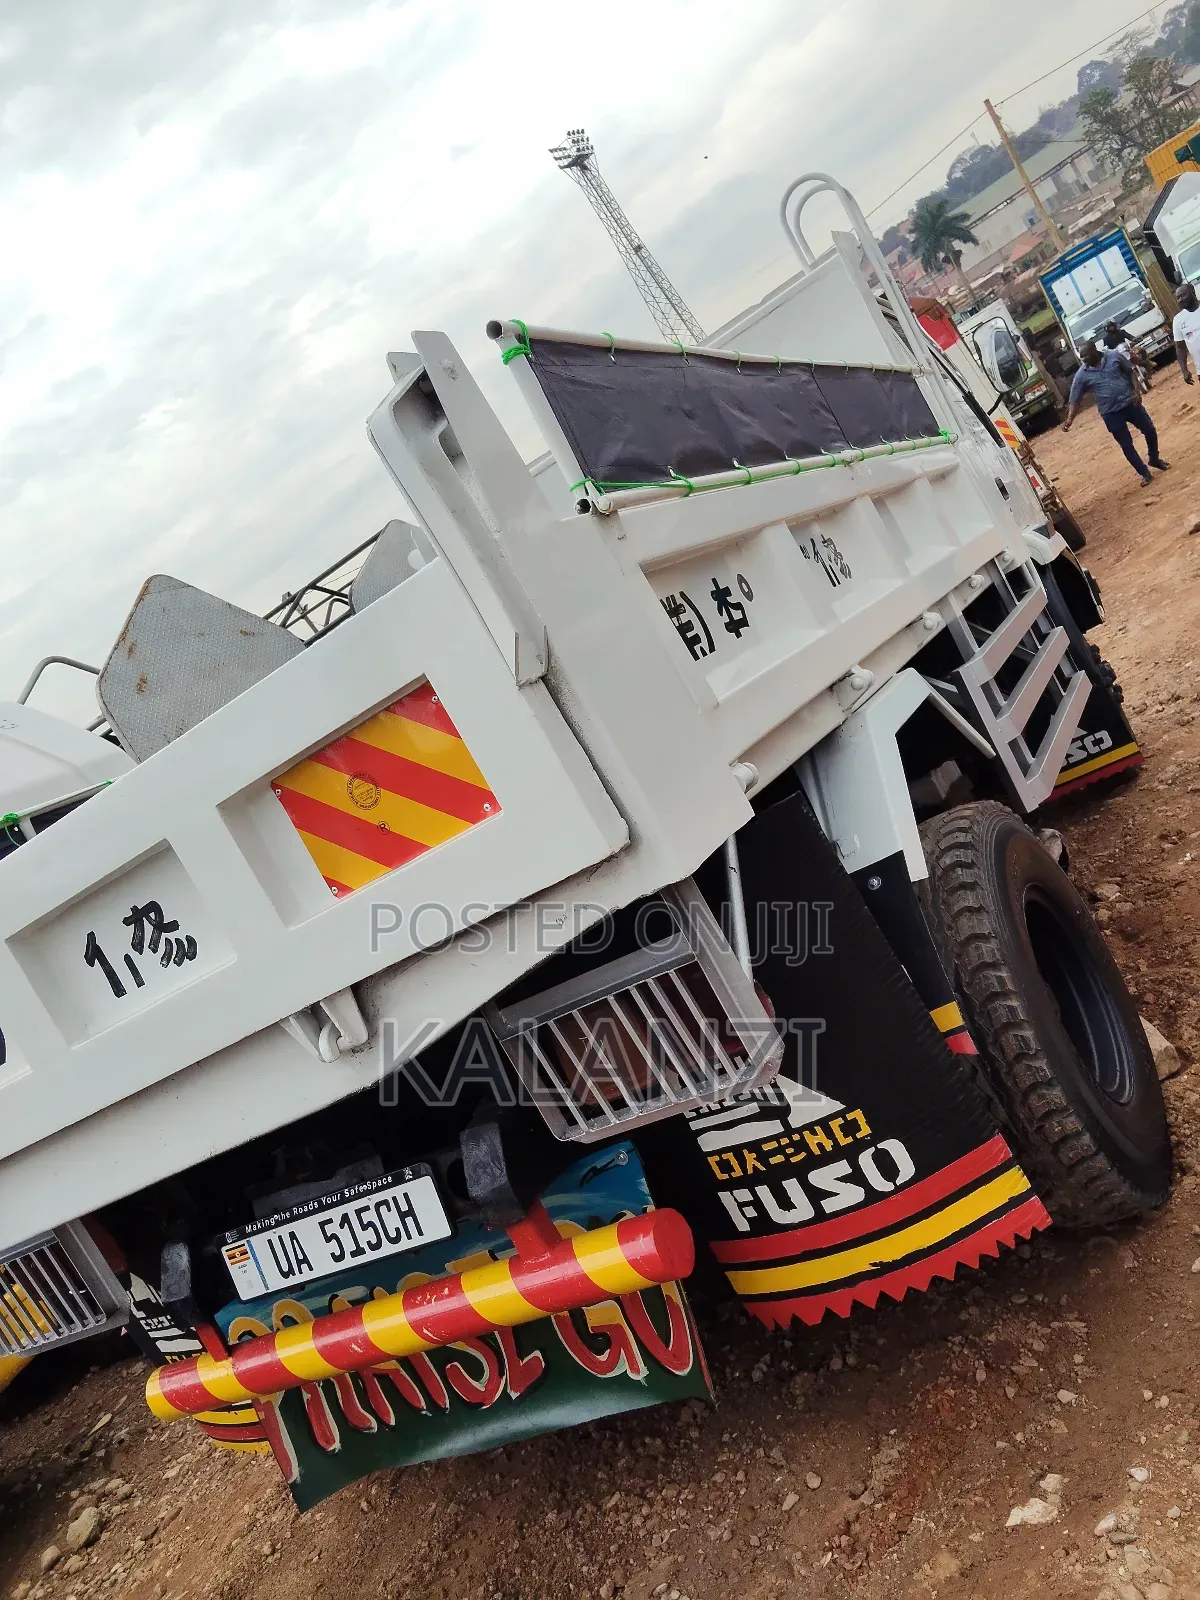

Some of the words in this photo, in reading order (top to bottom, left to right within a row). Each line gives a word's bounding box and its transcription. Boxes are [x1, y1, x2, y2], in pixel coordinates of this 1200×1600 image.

[245, 1217, 276, 1234] Making
[278, 1212, 291, 1221] the
[292, 1201, 319, 1216] Roads
[320, 1193, 341, 1206] Your
[344, 1183, 364, 1198] Safe
[366, 1175, 393, 1191] Space
[716, 1138, 916, 1232] FUSO
[266, 1230, 314, 1280] UA
[318, 1191, 424, 1263] 515CH
